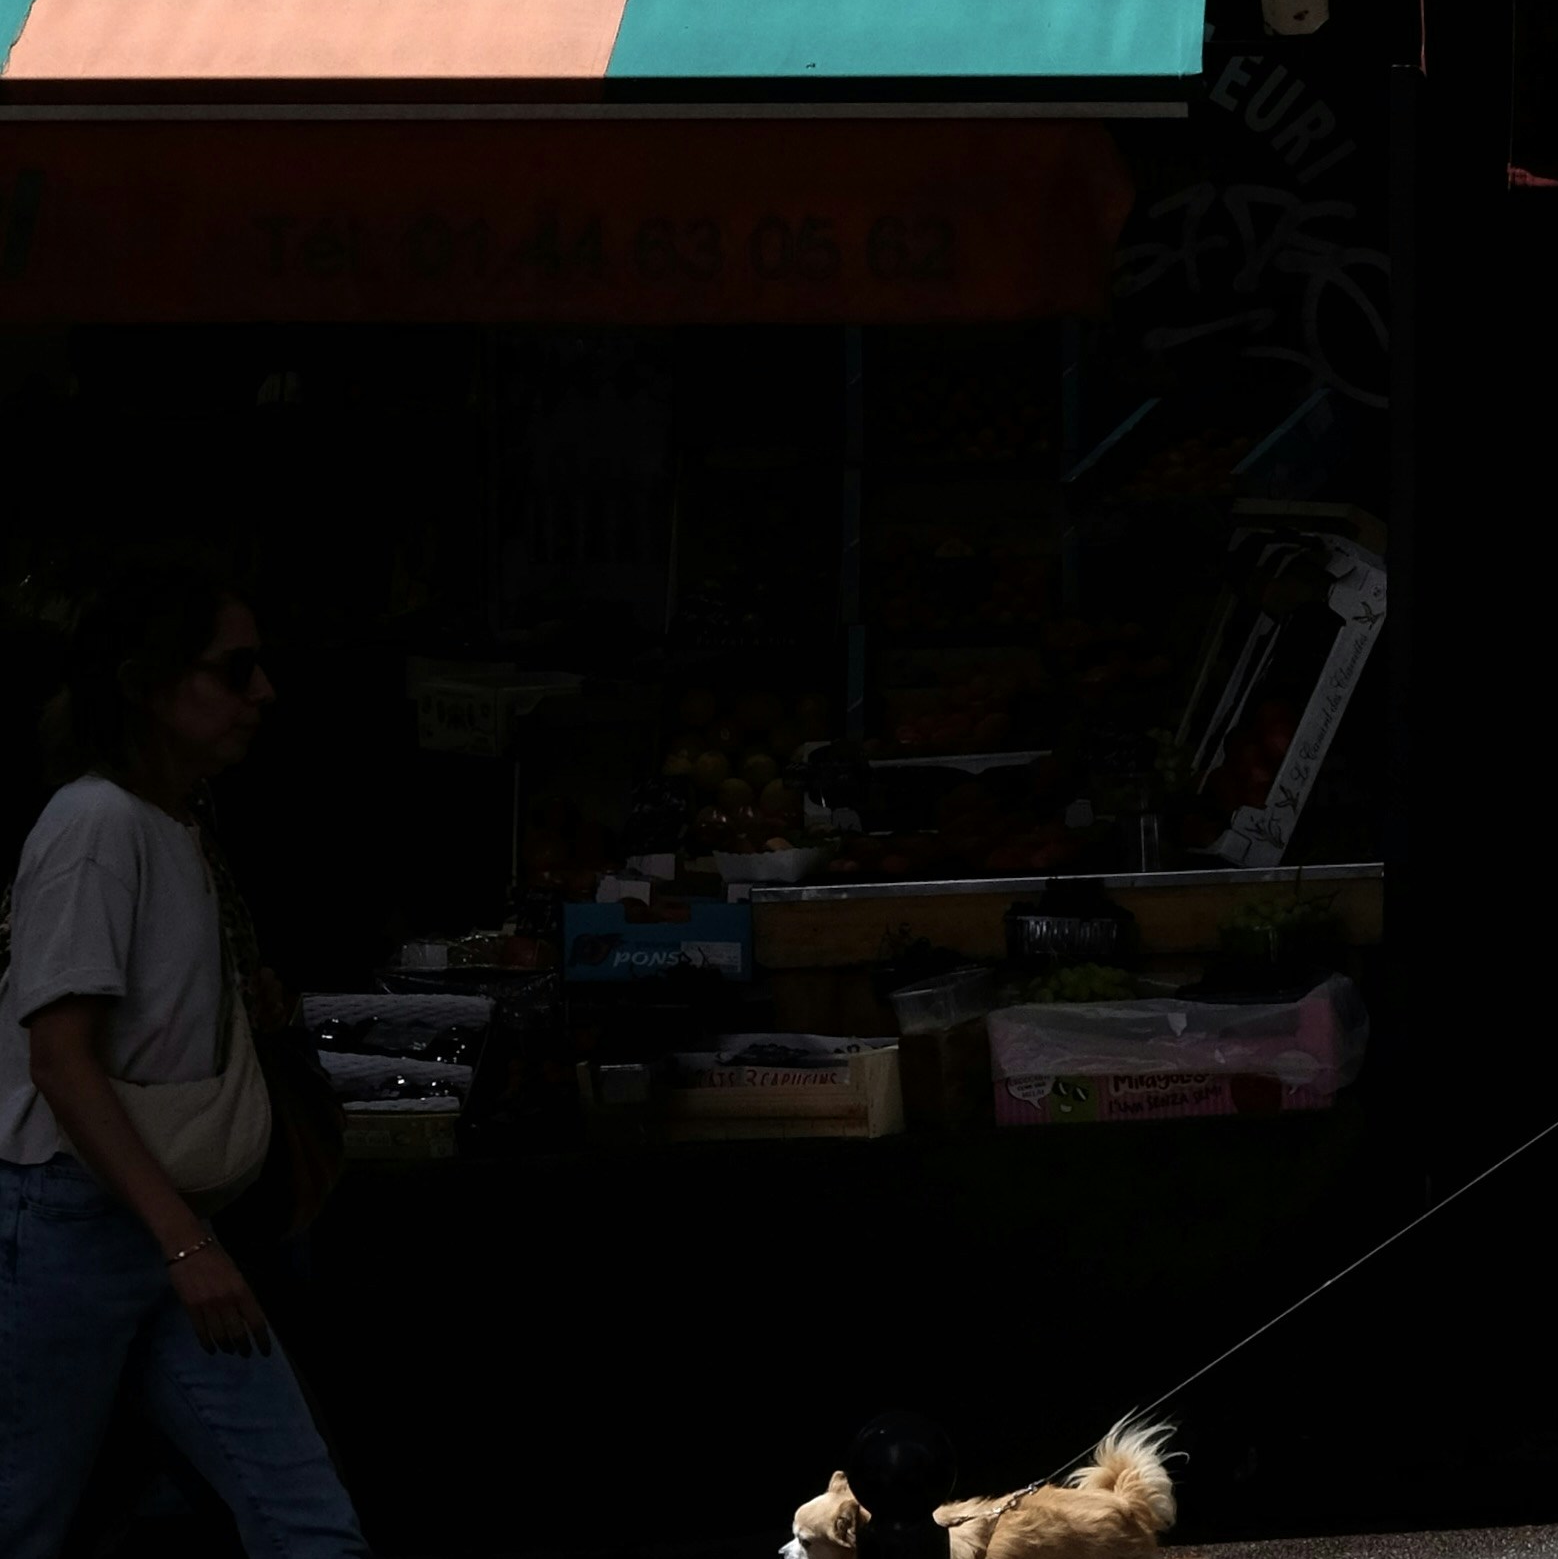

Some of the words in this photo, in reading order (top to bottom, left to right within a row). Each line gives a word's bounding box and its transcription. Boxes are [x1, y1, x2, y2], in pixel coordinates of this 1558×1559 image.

[406, 215, 490, 279] 01
[519, 216, 605, 279] 44
[866, 216, 957, 280] 62
